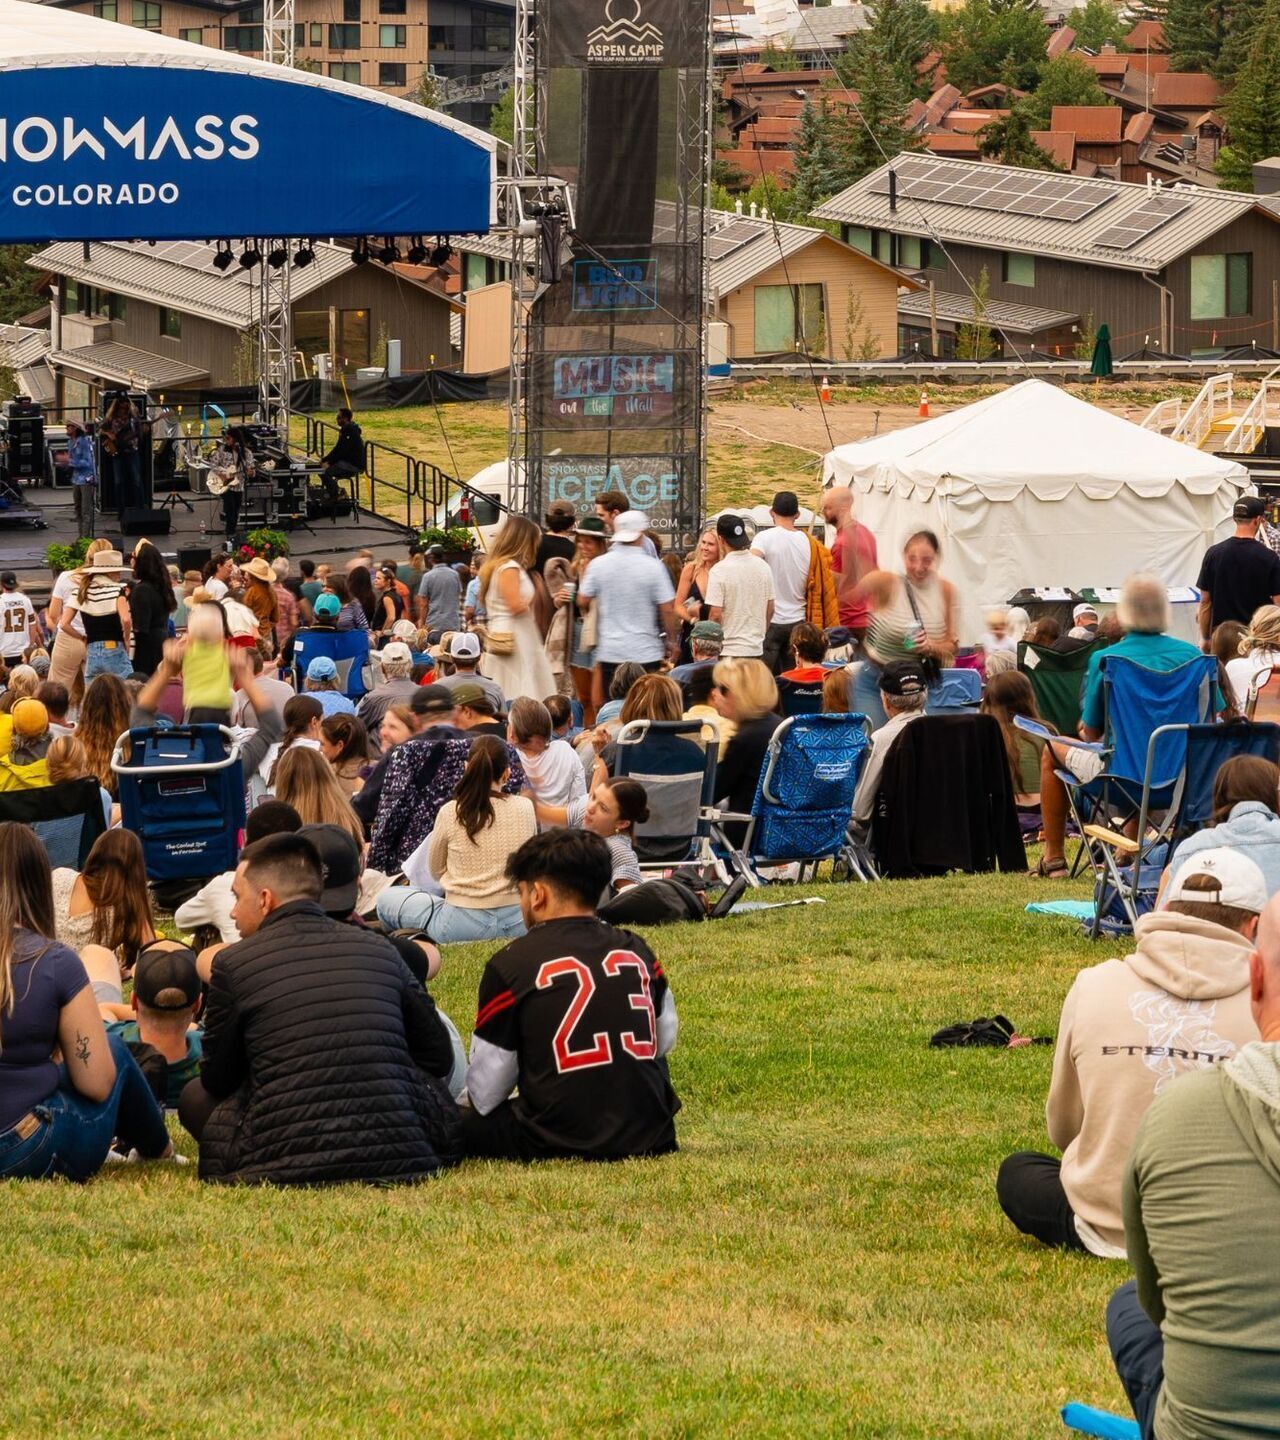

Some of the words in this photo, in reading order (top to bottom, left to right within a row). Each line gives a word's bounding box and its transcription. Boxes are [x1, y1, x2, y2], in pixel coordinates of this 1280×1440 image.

[587, 44, 626, 56] ASPEN
[628, 44, 664, 56] CAMP
[11, 182, 180, 207] COLORADO
[589, 265, 642, 284] BUD
[577, 285, 649, 306] LIGHT
[560, 355, 667, 395] MUSIC
[559, 401, 578, 415] on
[592, 399, 608, 414] the
[625, 395, 653, 414] Mall
[4, 607, 26, 633] 13
[535, 949, 658, 1074] 23
